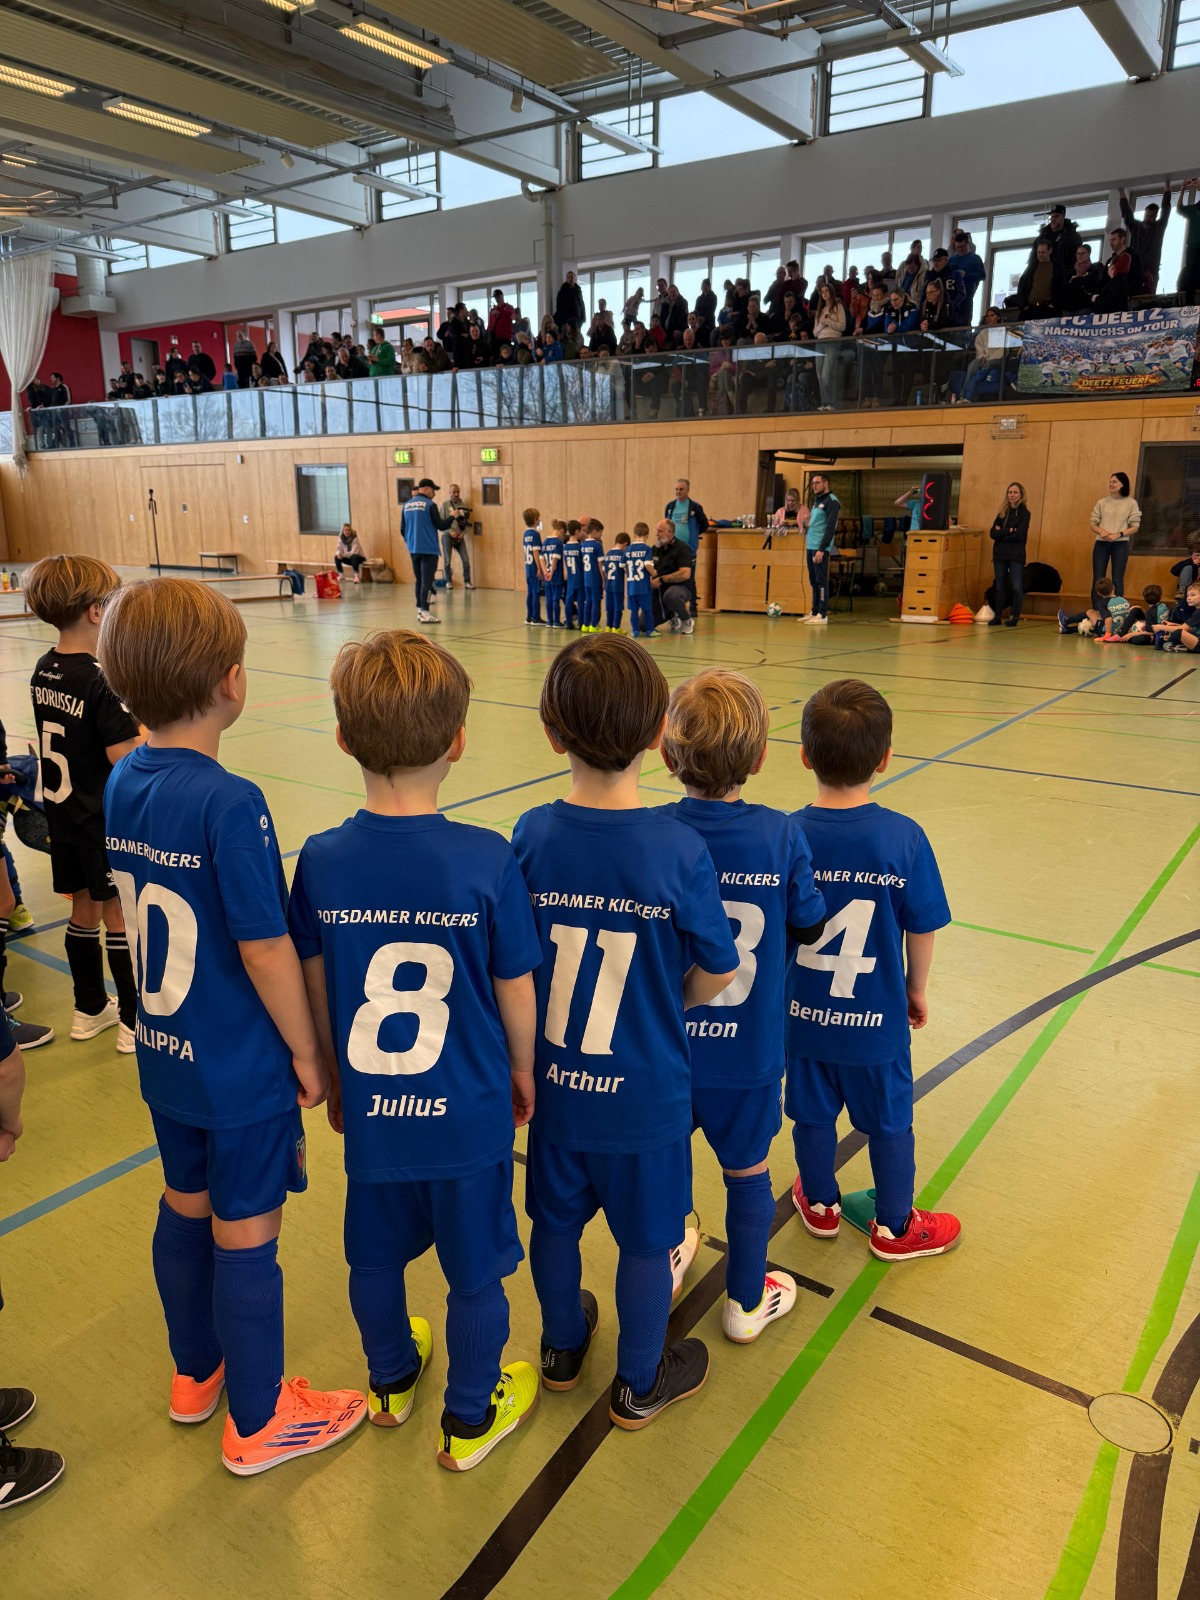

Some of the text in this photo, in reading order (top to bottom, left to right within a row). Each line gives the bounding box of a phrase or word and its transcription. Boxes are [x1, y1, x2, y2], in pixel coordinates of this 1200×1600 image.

[1092, 307, 1164, 326] DEETZ
[1044, 319, 1179, 337] NACHWUCHS ON TOUR
[1082, 377, 1148, 387] DEETZ FEUER!
[583, 554, 591, 571] 8
[607, 562, 616, 580] 2
[627, 559, 645, 581] 13
[35, 686, 85, 719] BORUSSIA
[42, 721, 73, 804] 5
[105, 836, 149, 858] SDAMER
[720, 872, 781, 887] KICKERS
[528, 892, 671, 920] TSDAMER KICKERS
[414, 912, 480, 927] KICKERS
[796, 898, 877, 999] 4
[544, 923, 638, 1056] 11
[347, 942, 455, 1076] 8
[789, 999, 884, 1028] Benjamin
[134, 1013, 195, 1062] HILIPPA
[685, 1019, 738, 1038] nton
[545, 1062, 625, 1094] Arthur
[366, 1095, 448, 1117] Julius
